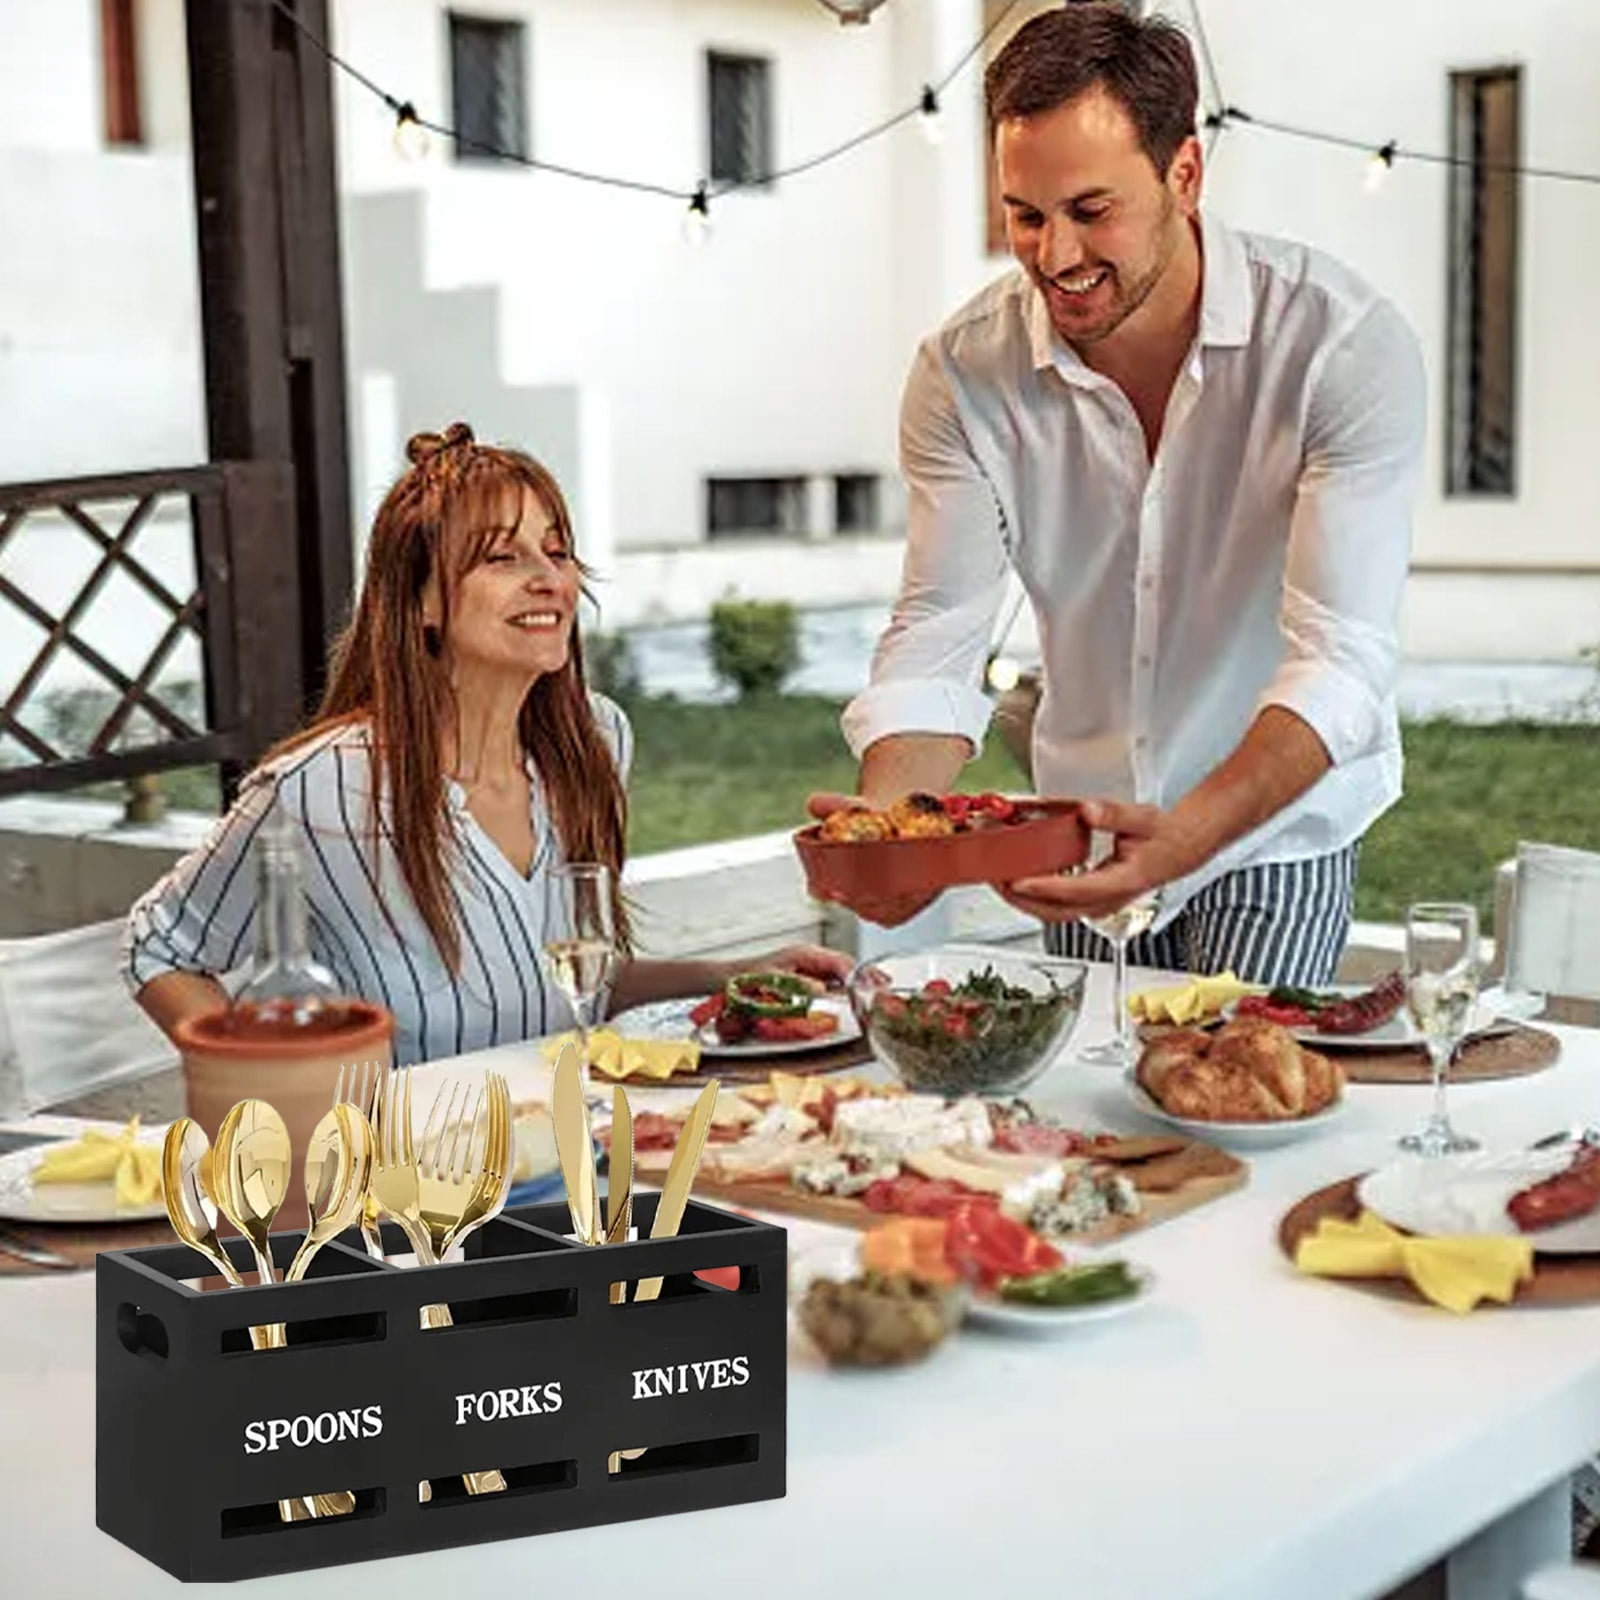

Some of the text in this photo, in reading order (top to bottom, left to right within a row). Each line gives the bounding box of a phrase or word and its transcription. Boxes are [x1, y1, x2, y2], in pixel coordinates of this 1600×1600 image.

[631, 1356, 750, 1400] KNIVES
[455, 1381, 563, 1425] FORKS
[243, 1405, 383, 1454] SPOONS
